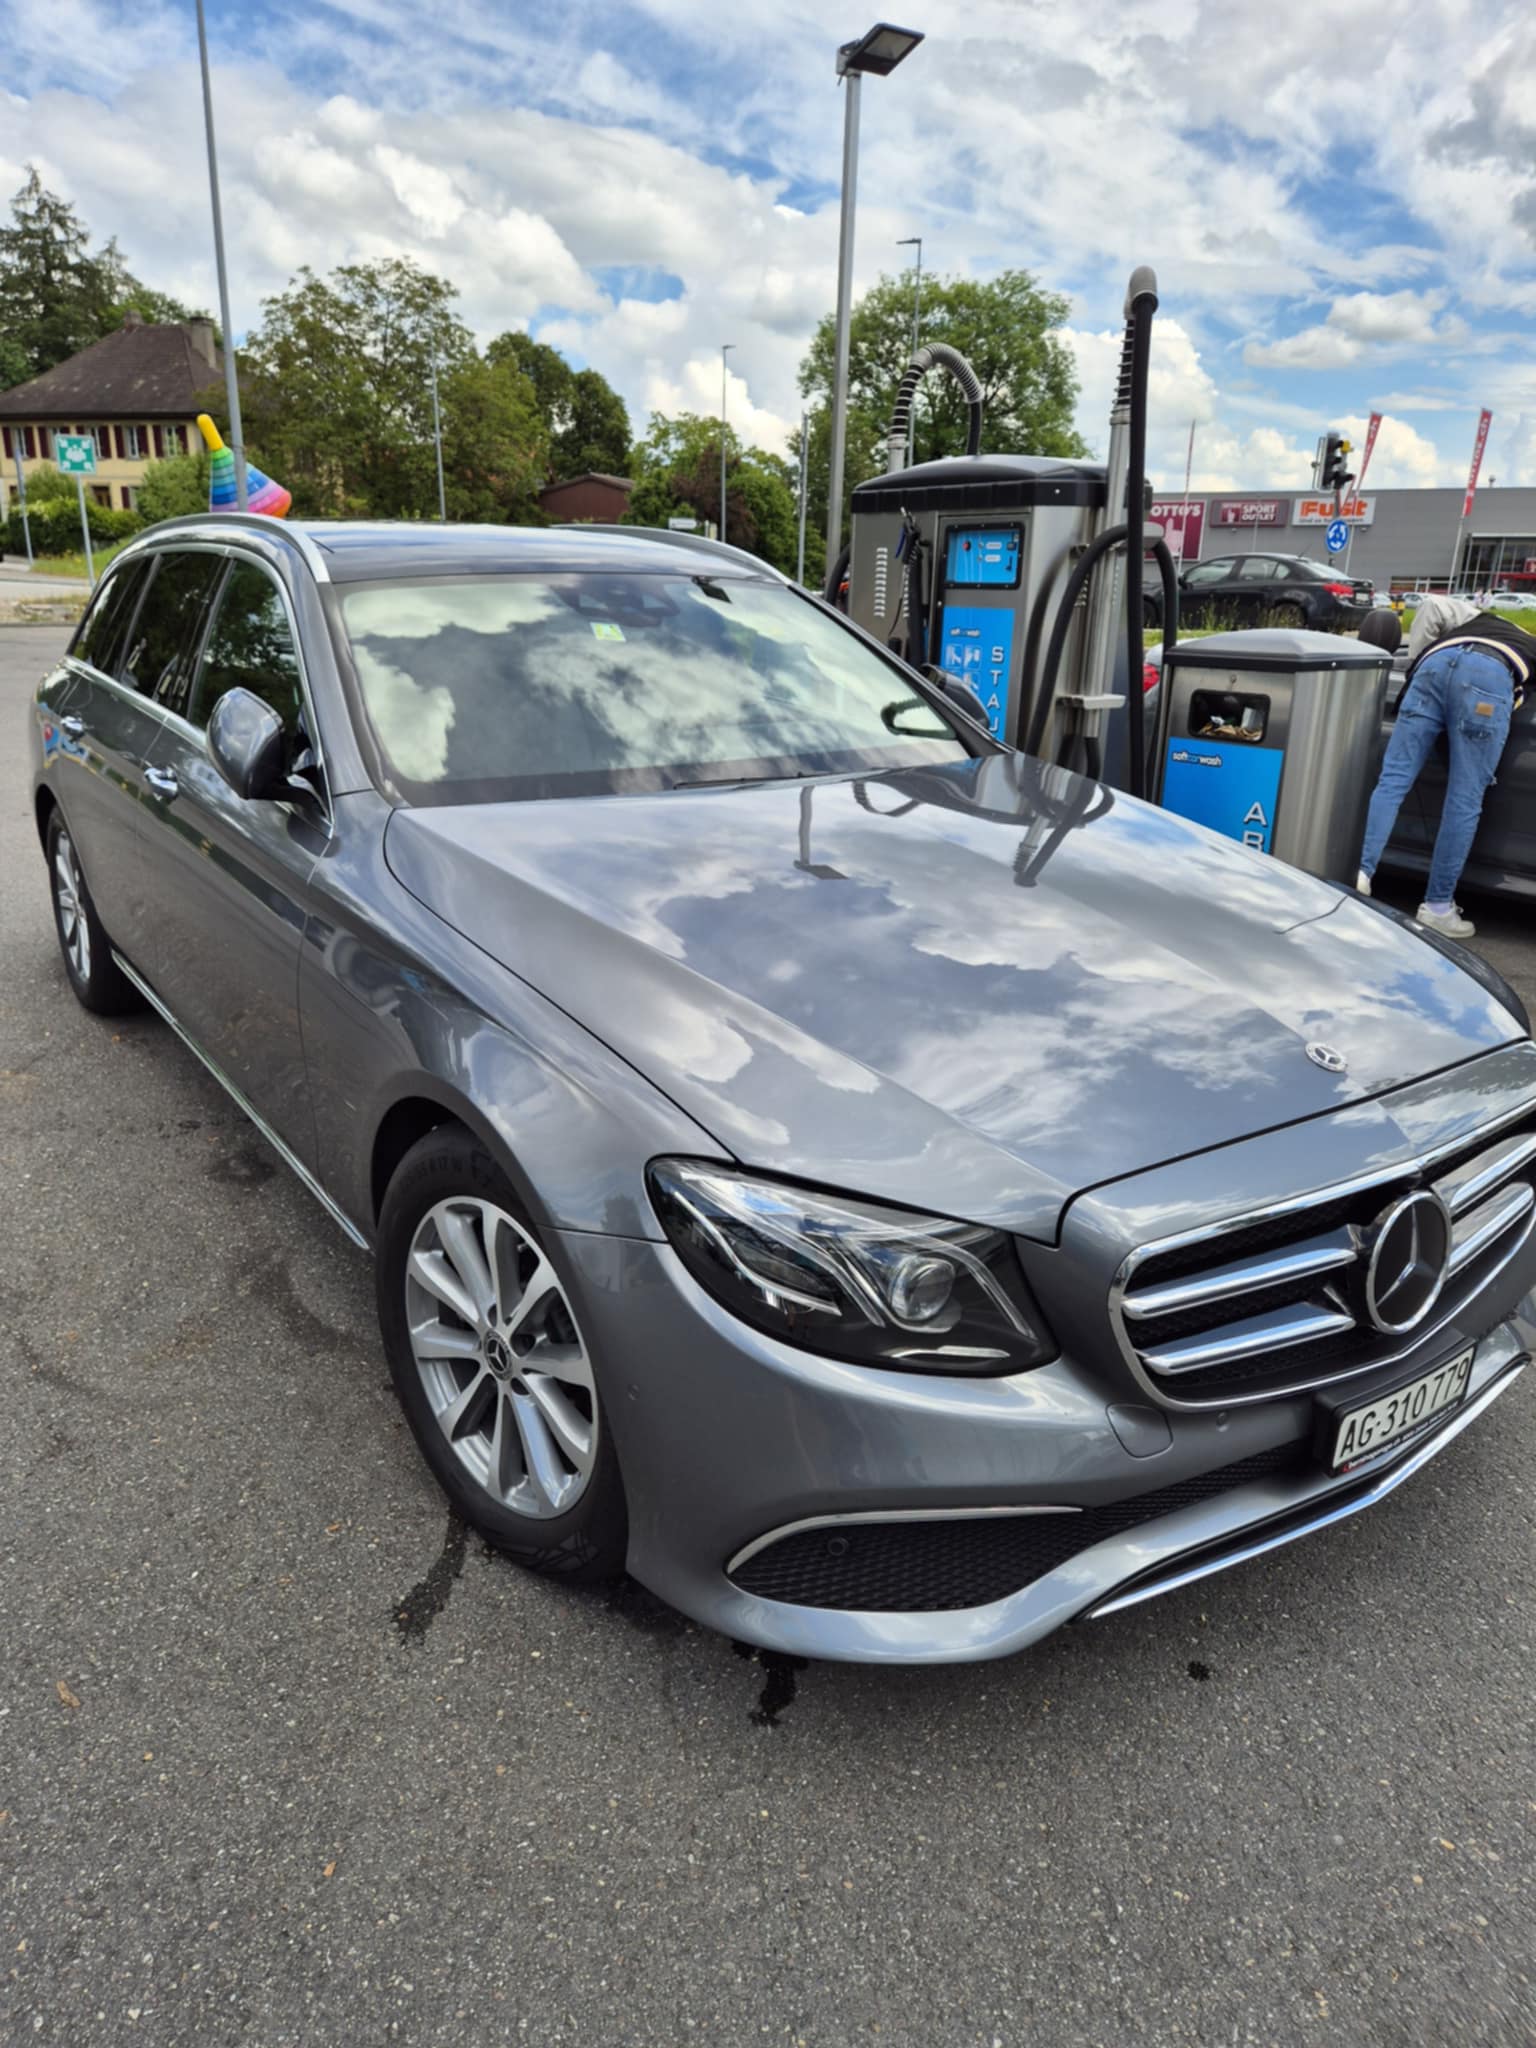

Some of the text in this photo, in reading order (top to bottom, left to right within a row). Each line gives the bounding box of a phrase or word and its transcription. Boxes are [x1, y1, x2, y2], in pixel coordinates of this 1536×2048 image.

[1151, 504, 1201, 517] OTTO'S
[1243, 503, 1276, 514] SPORT
[1242, 513, 1275, 522] OUTLET
